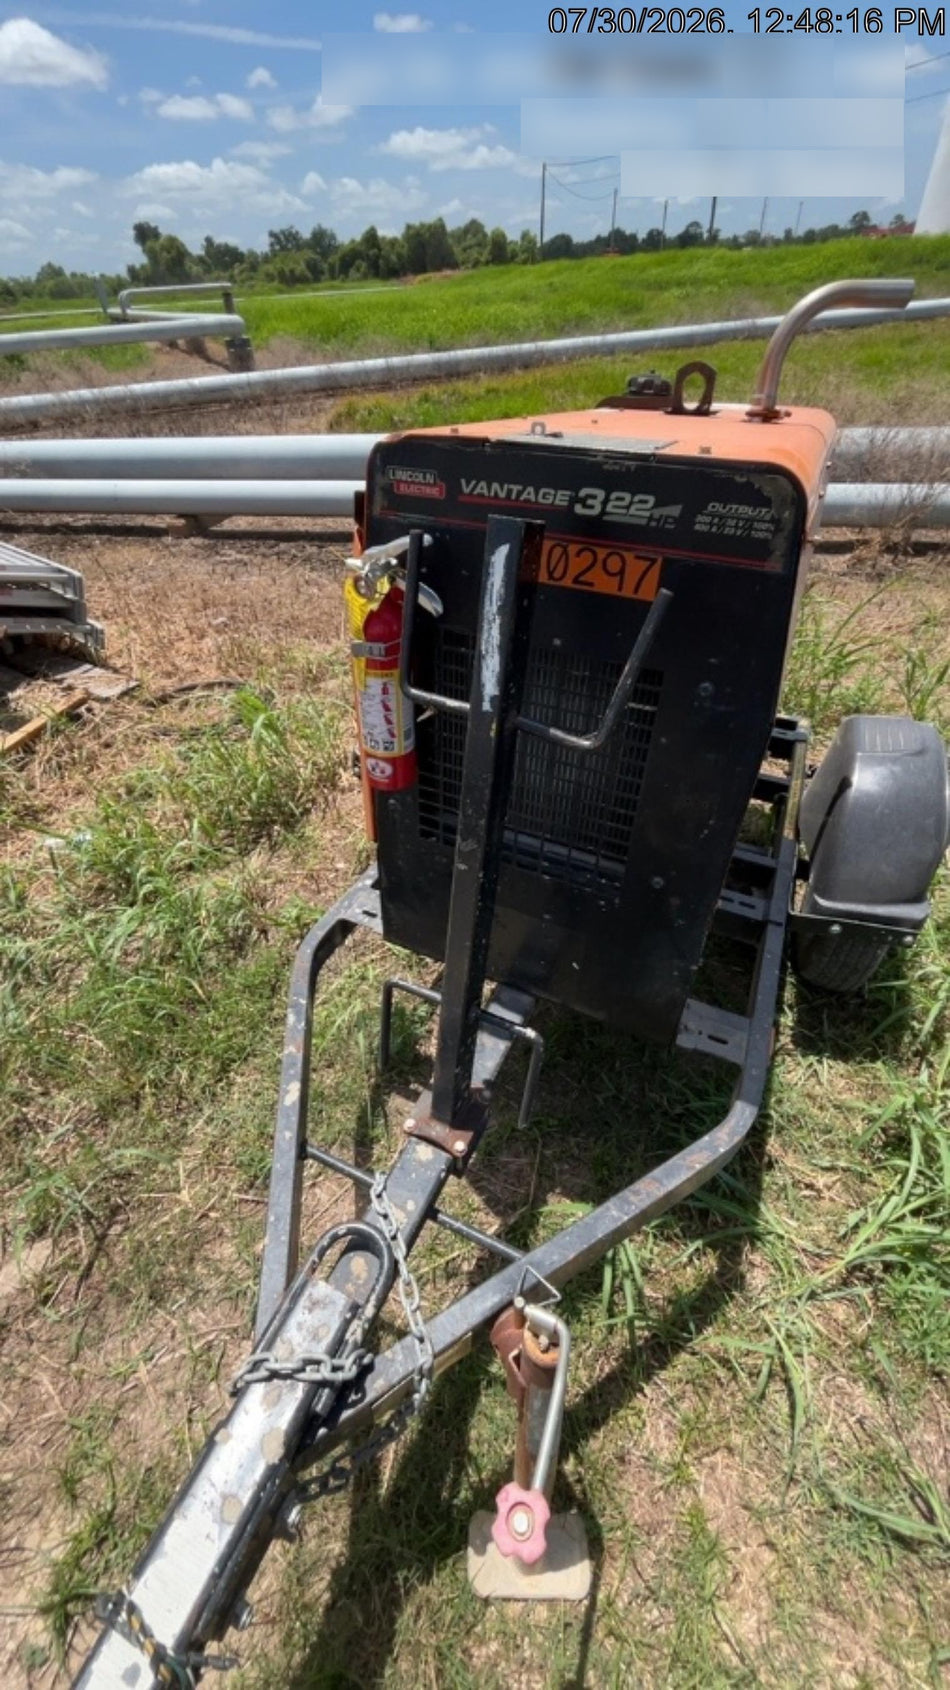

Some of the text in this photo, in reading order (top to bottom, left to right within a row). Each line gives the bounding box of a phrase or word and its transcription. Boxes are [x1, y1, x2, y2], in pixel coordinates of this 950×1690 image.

[389, 468, 435, 484] LINCOLN
[398, 482, 441, 497] ELECTRIC
[460, 478, 572, 507] VANTAGE
[573, 487, 657, 517] 322
[707, 502, 771, 516] OUTPUT
[546, 542, 659, 595] 0297
